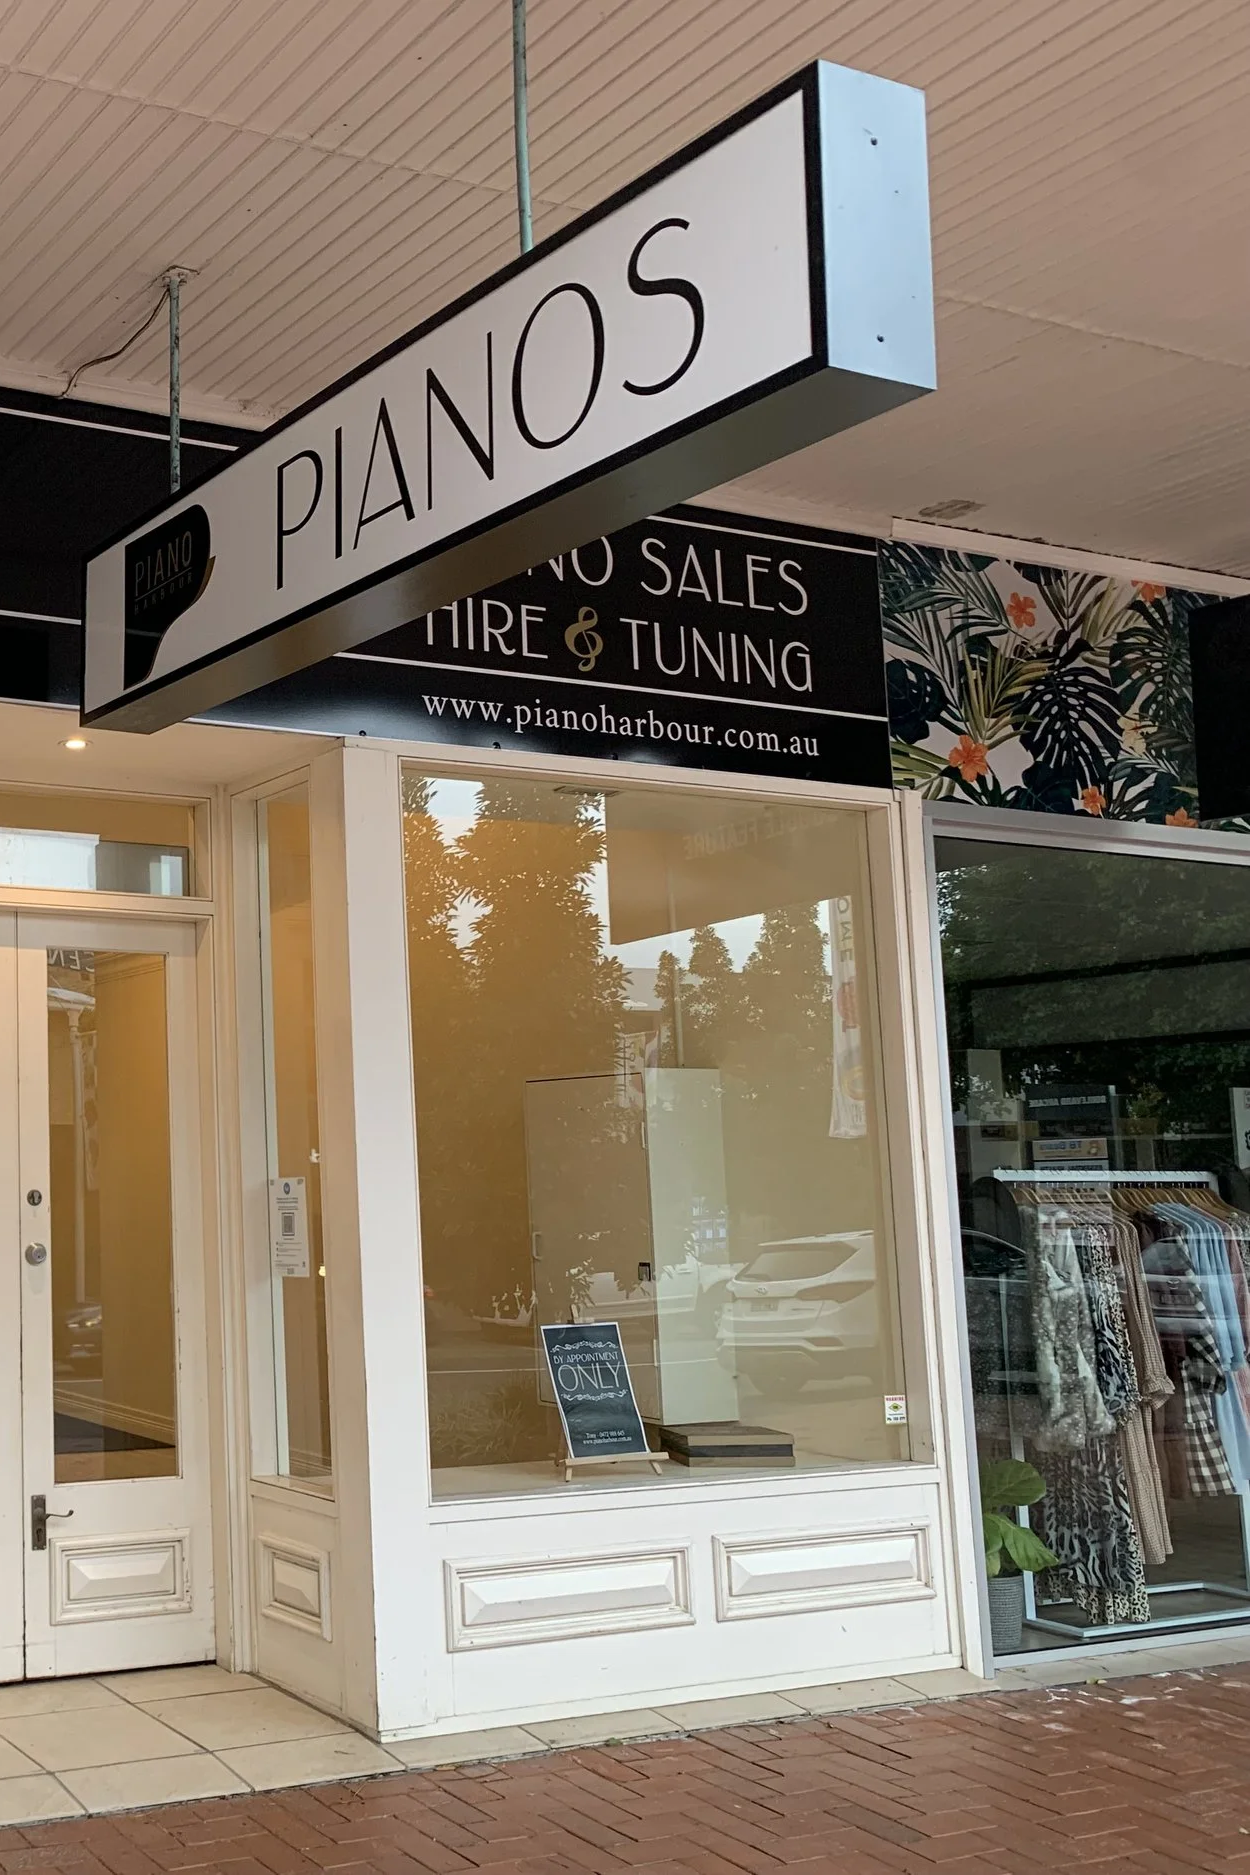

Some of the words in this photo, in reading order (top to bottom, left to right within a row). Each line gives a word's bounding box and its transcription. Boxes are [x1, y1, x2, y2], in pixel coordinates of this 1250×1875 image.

[275, 217, 705, 590] PIANOS
[135, 530, 193, 597] PIANO
[640, 537, 809, 616] SALES
[426, 597, 548, 660] HIRE
[619, 617, 813, 692] TUNING
[422, 694, 820, 758] www.pianoharbour.com.au
[554, 1355, 564, 1364] BY
[566, 1351, 619, 1364] APPOINTMENT
[557, 1361, 621, 1392] ONLY
